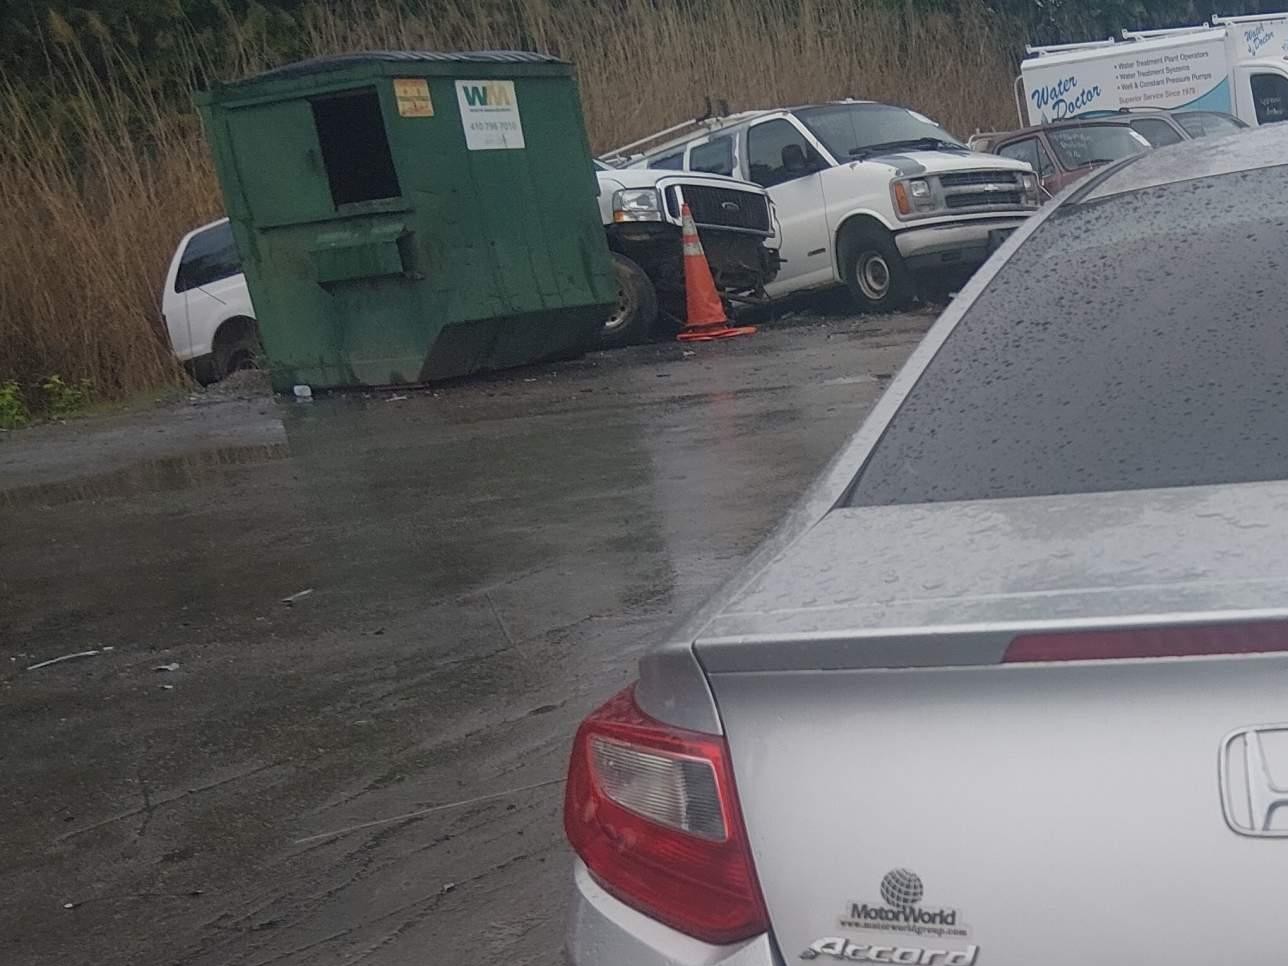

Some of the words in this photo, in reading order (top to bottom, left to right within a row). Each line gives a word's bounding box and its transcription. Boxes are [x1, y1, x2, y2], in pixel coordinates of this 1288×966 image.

[1118, 61, 1135, 71] Water
[1136, 56, 1163, 68] Treatment
[1164, 54, 1179, 64] Plant
[1179, 51, 1209, 62] Operators
[1119, 72, 1136, 81] Water
[1137, 66, 1165, 78] Treatment
[1165, 64, 1191, 76] Systems
[1139, 77, 1165, 89] Constant
[1165, 74, 1191, 85] Pressure
[1191, 72, 1213, 82] Pumps
[462, 84, 511, 107] WM
[1031, 75, 1078, 109] Water
[1118, 95, 1142, 105] Superior
[1143, 92, 1164, 102] Service
[1164, 89, 1181, 99] Since
[1051, 84, 1102, 123] Doctor
[850, 902, 957, 927] MotorWorld
[839, 918, 968, 938] www.motorworldgroup.com
